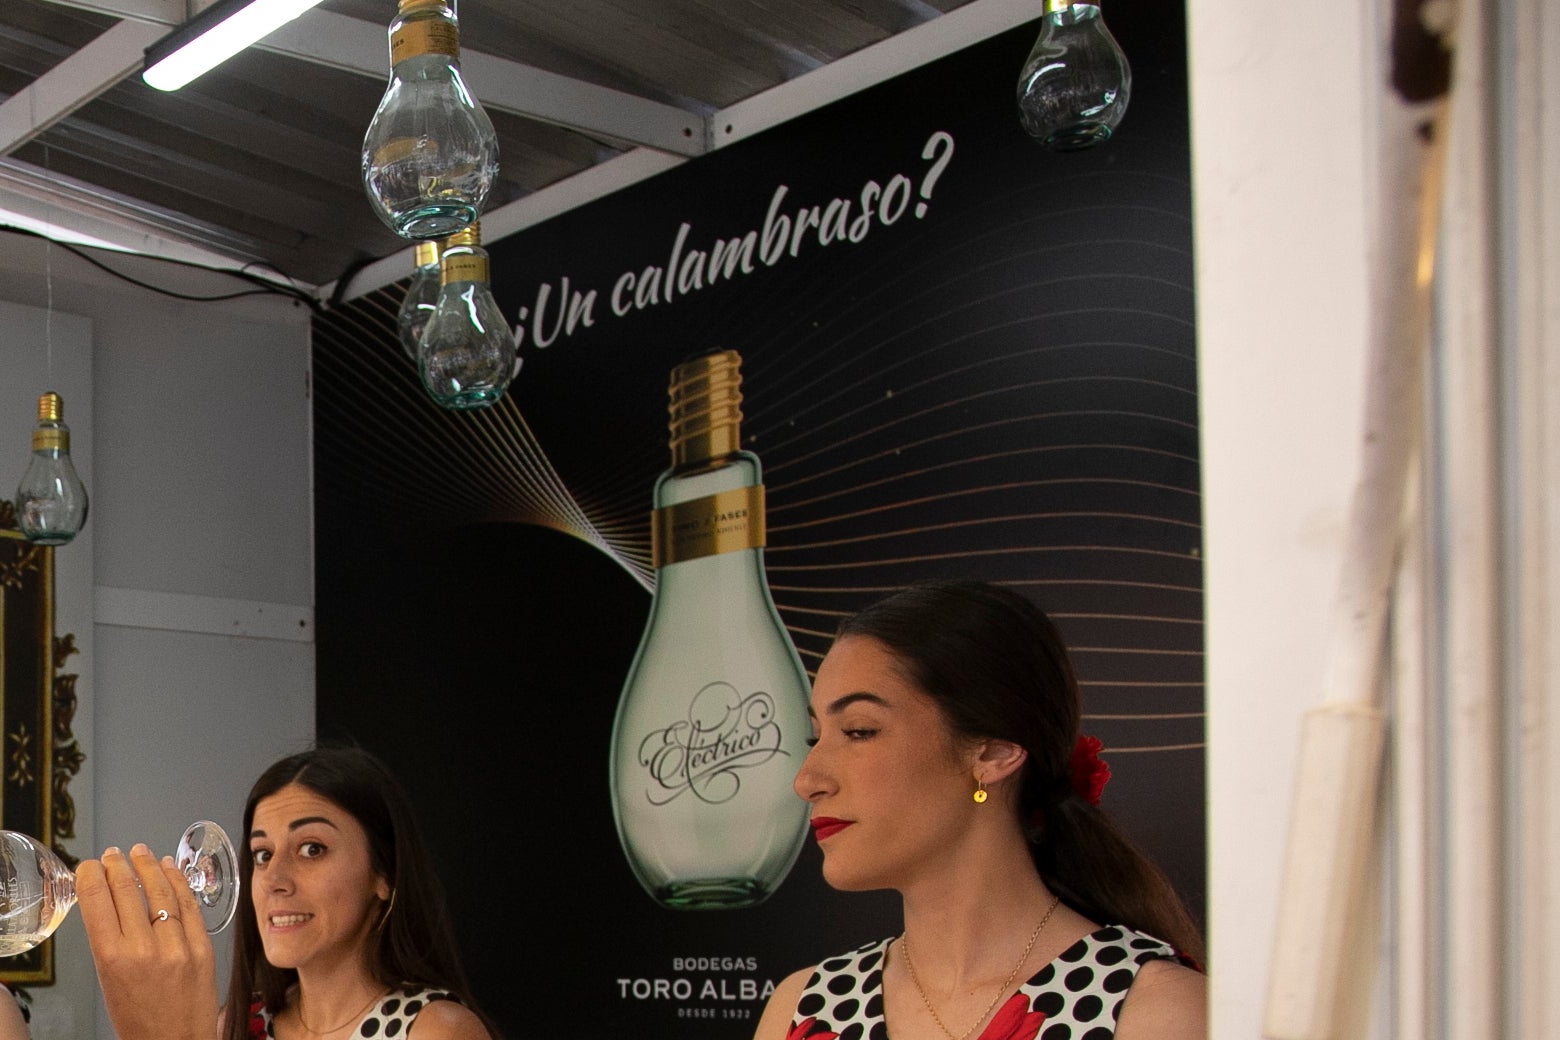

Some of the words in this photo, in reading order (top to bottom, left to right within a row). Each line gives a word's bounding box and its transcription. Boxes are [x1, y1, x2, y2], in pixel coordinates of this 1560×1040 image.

[611, 131, 955, 317] calambraso?
[673, 957, 758, 971] BODEGAS
[617, 978, 692, 1000] TORO
